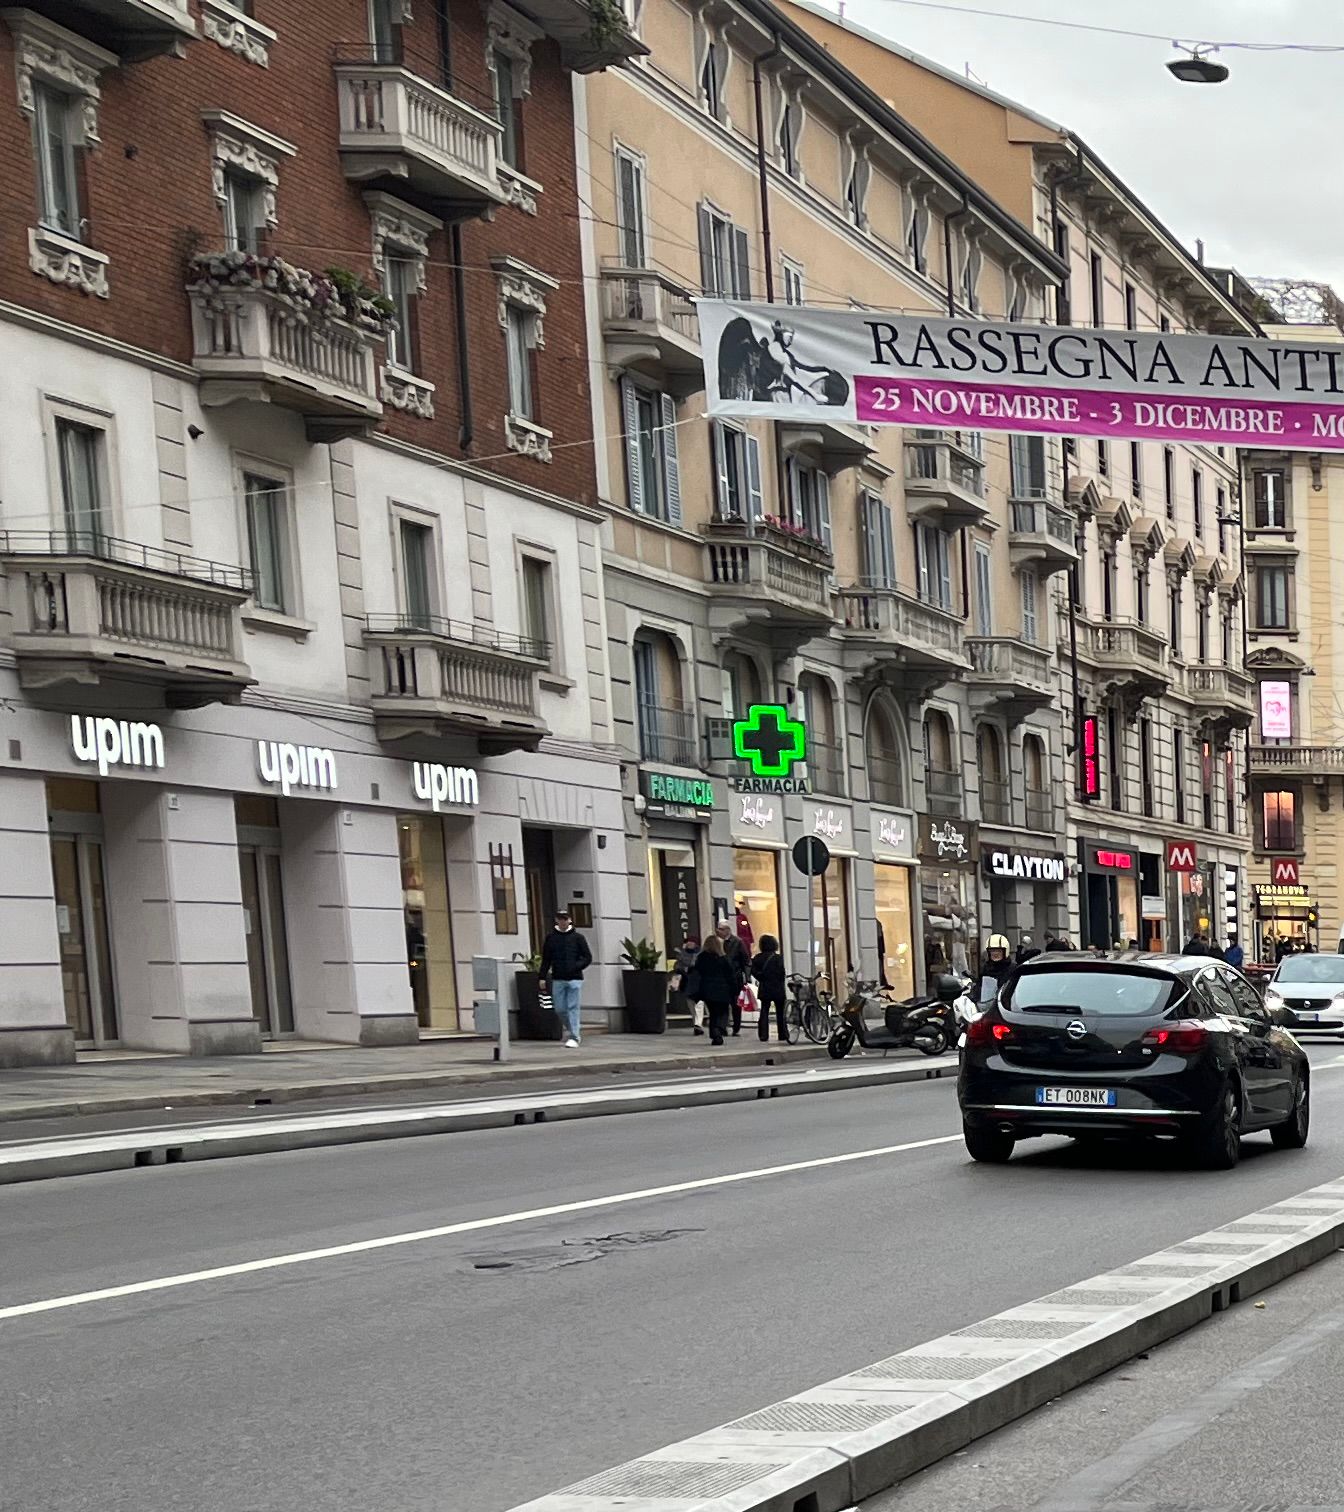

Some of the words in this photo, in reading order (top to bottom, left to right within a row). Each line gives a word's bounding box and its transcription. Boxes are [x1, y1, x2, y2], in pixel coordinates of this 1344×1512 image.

[863, 320, 1185, 385] RASSEGNA
[872, 386, 901, 412] 25
[911, 387, 1081, 423] NOVEMBRE
[1108, 402, 1123, 426] 3
[1133, 402, 1285, 435] DICEMBRE
[71, 714, 166, 777] upim
[256, 739, 339, 797] upim
[412, 761, 480, 812] upim
[650, 774, 714, 807] FARMACIA
[735, 777, 807, 794] FARMACIA
[991, 852, 1064, 881] CLAYTON
[1169, 846, 1196, 868] M
[1275, 863, 1297, 880] M
[1045, 1088, 1061, 1102] ET
[1065, 1089, 1106, 1104] 008NK
